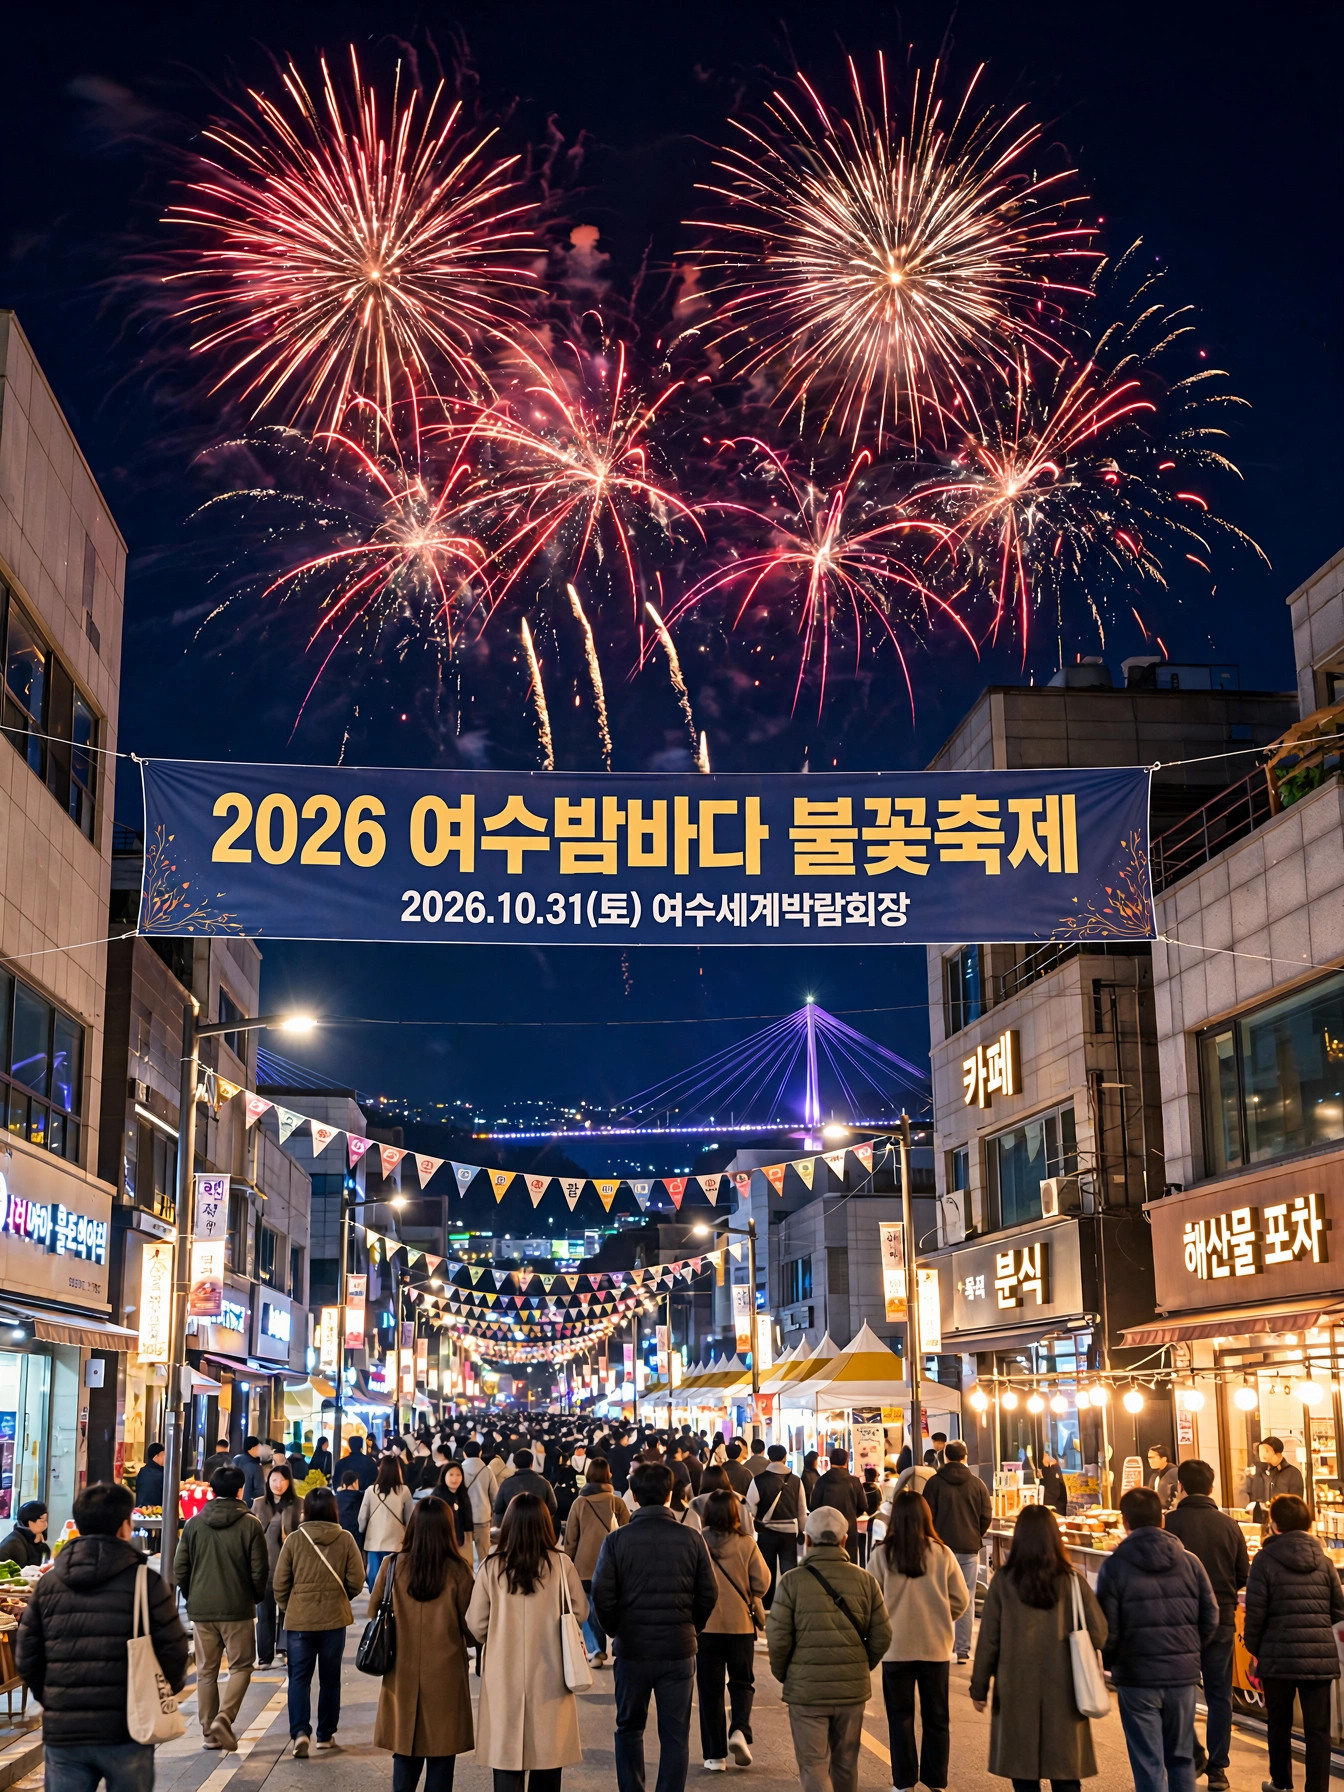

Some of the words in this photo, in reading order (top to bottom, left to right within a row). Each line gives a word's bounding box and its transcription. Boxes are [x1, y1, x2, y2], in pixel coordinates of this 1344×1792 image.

[211, 792, 387, 868] 2026
[409, 794, 769, 876] 여수밤바다
[788, 793, 1079, 876] 불꽃축제
[400, 889, 642, 928] 2026.10.31(토)
[652, 891, 911, 928] 여수세계박람회장
[962, 1030, 1014, 1109] 카페
[994, 1242, 1043, 1310] 분식
[1183, 1207, 1257, 1280] 해산물
[1264, 1193, 1324, 1266] 포차
